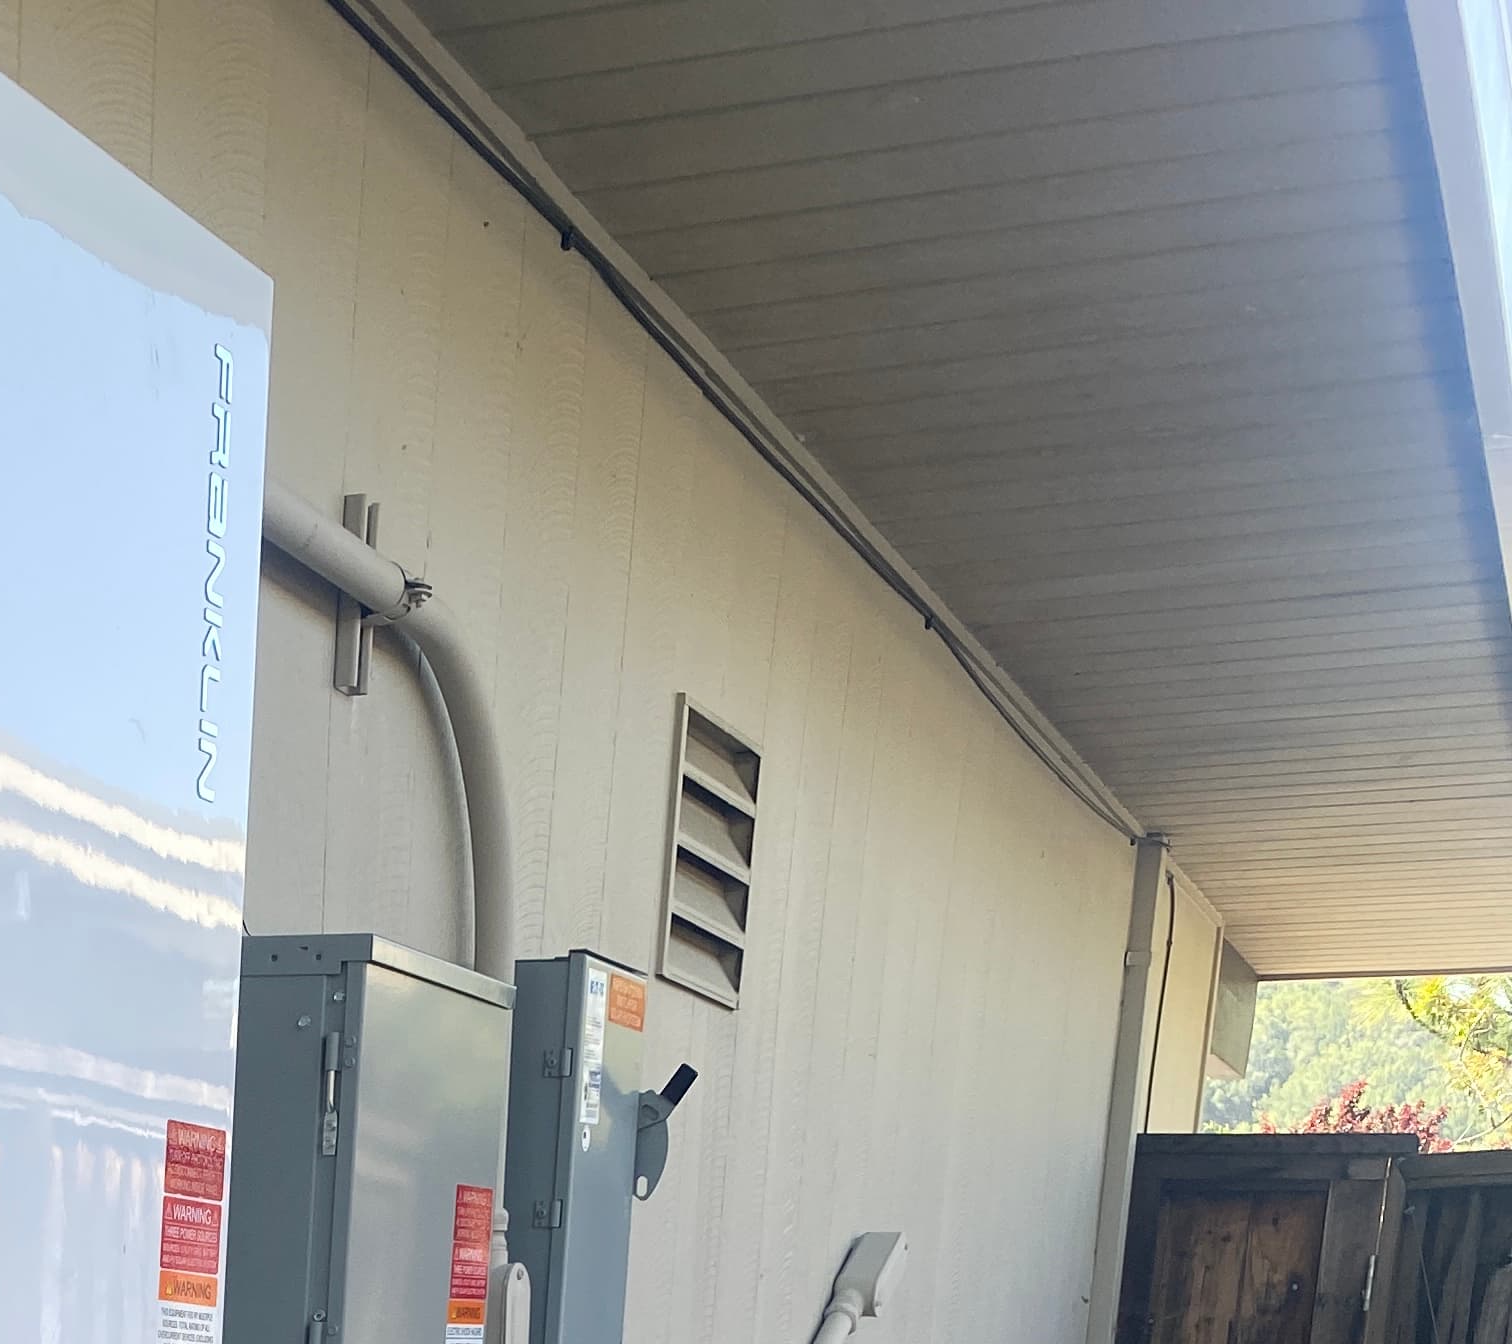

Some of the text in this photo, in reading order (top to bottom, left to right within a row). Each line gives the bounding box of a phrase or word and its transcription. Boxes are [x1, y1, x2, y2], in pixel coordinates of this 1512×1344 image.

[197, 344, 233, 803] FRANKLIN
[173, 1206, 211, 1225] WARNING
[173, 1280, 211, 1299] WARNING
